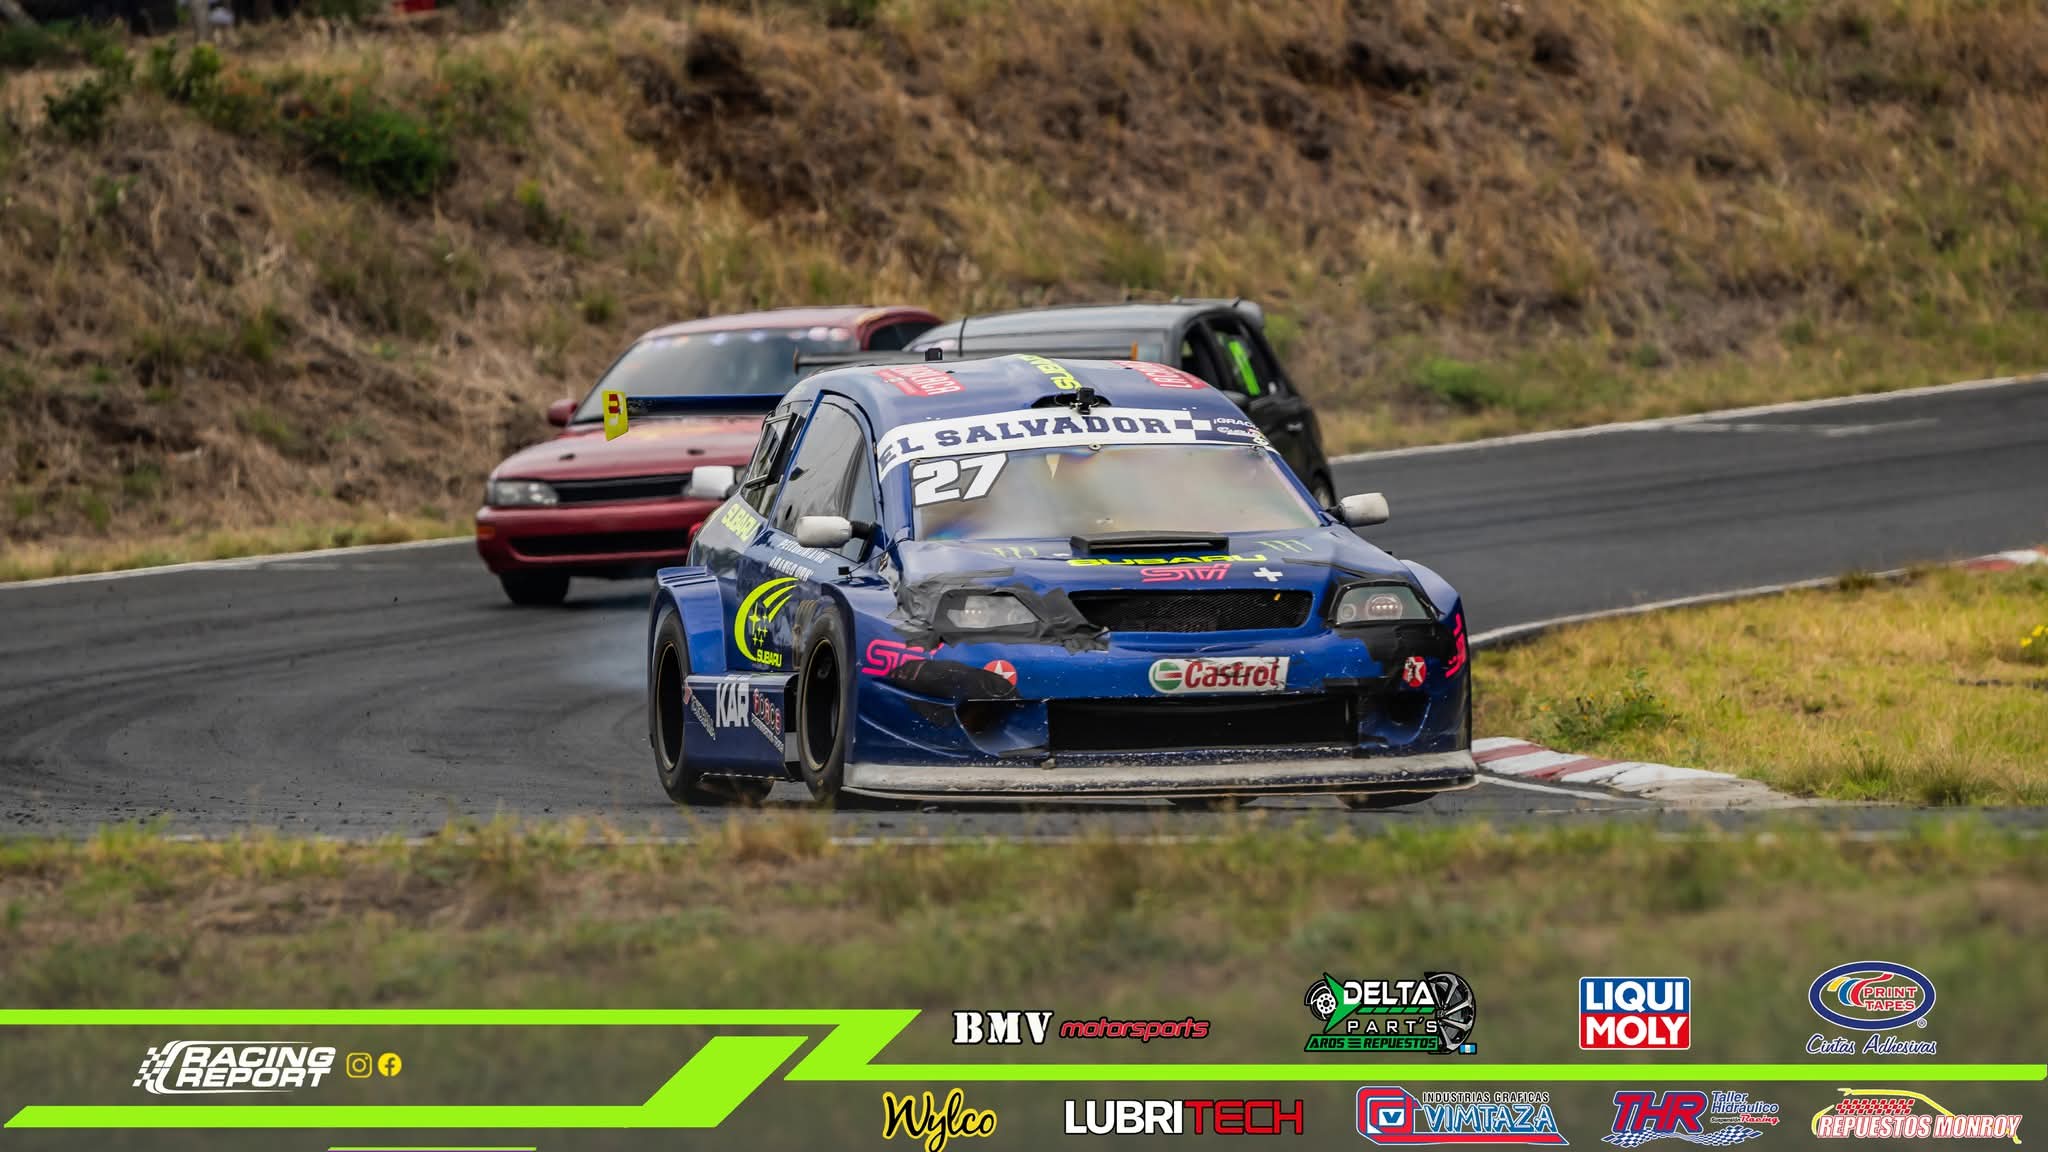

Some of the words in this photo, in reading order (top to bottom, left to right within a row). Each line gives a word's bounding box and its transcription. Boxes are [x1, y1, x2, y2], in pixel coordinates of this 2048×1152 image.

[879, 437, 924, 472] EL
[935, 416, 1171, 447] SALVADOR
[912, 453, 1008, 506] 27
[1066, 554, 1267, 566] SUBARU
[756, 649, 783, 668] SUBARU
[1184, 657, 1280, 689] Castrol
[716, 681, 750, 728] KAR
